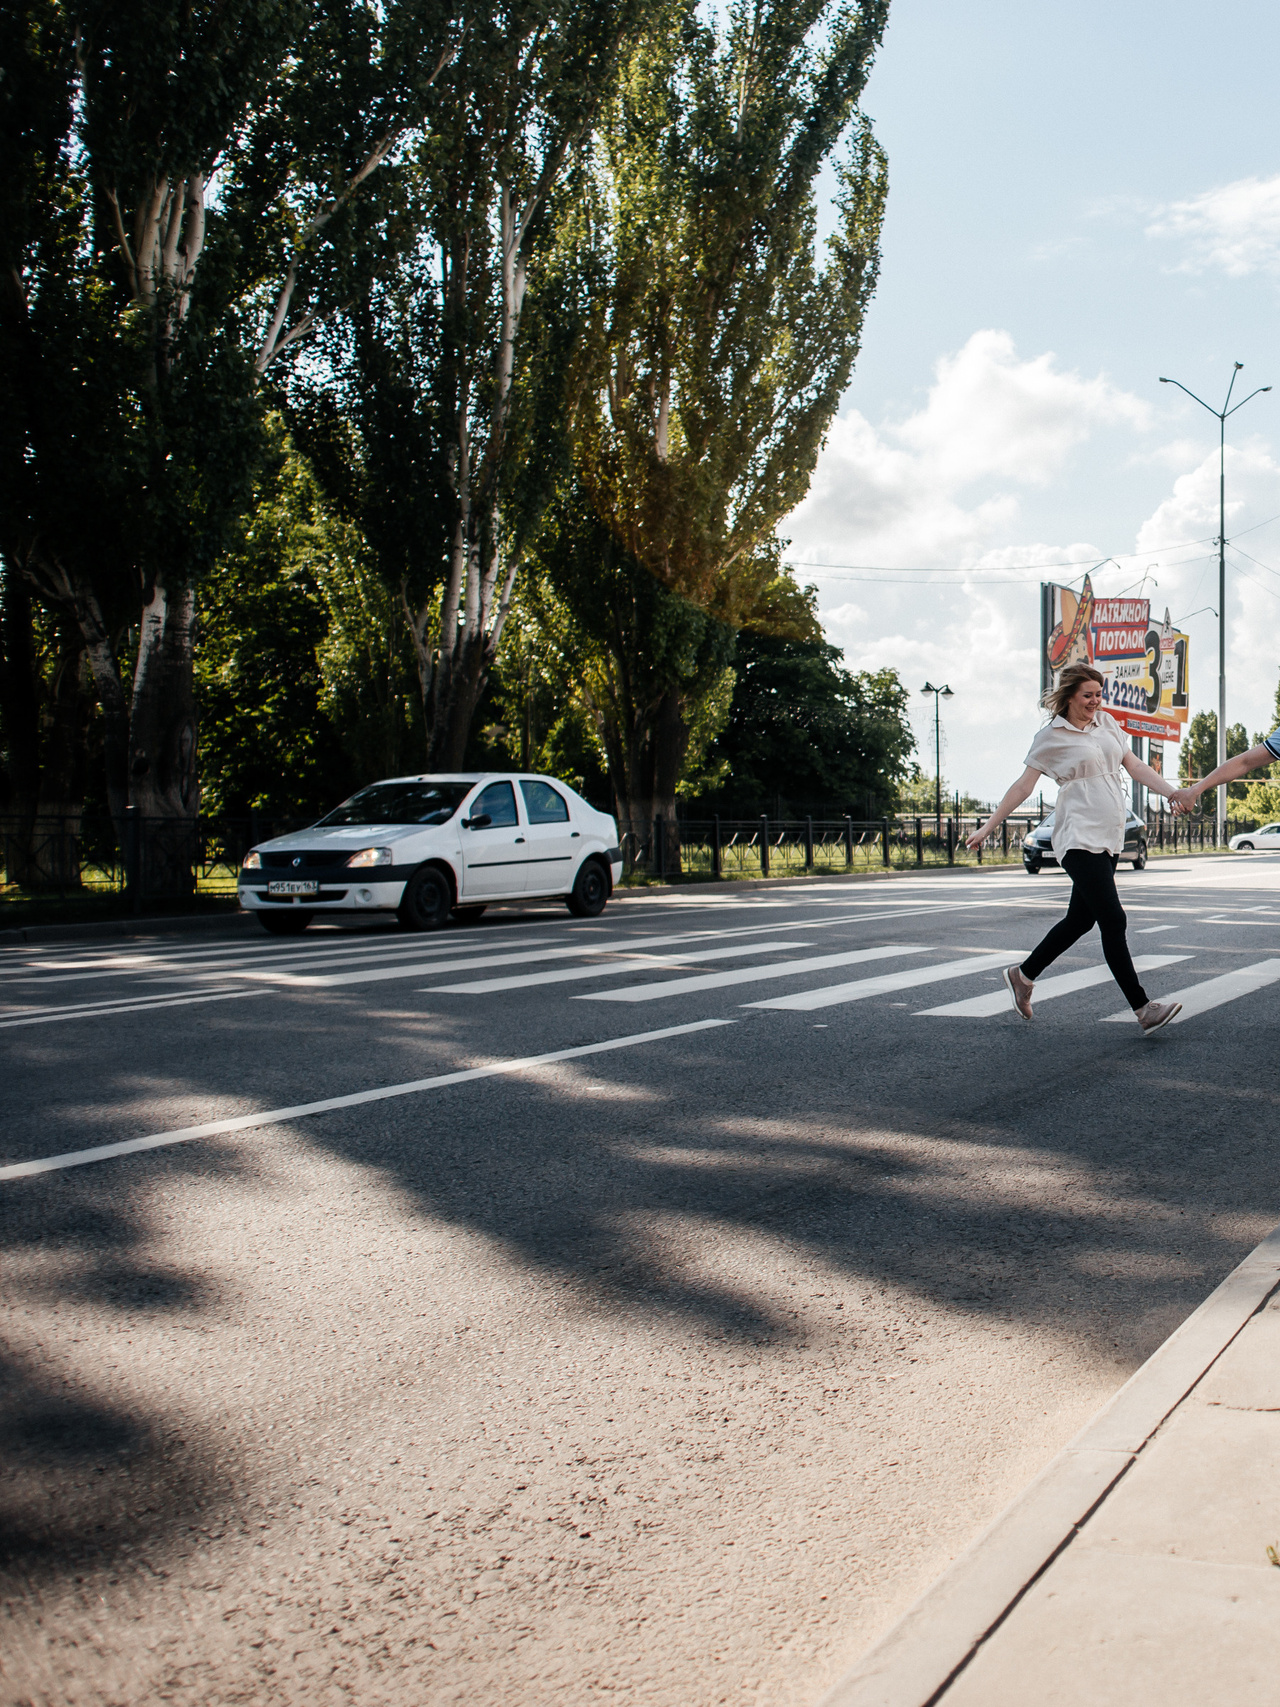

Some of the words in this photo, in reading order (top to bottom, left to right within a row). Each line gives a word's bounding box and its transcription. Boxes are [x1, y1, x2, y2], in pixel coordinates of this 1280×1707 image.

[1094, 601, 1148, 623] НАТЯЖНОЙ
[1099, 630, 1145, 651] ПОТОЛОК
[1115, 664, 1141, 679] ЗАКАЖИ
[1145, 630, 1160, 714] 3
[1165, 659, 1172, 670] ПО
[1172, 639, 1187, 707] 1
